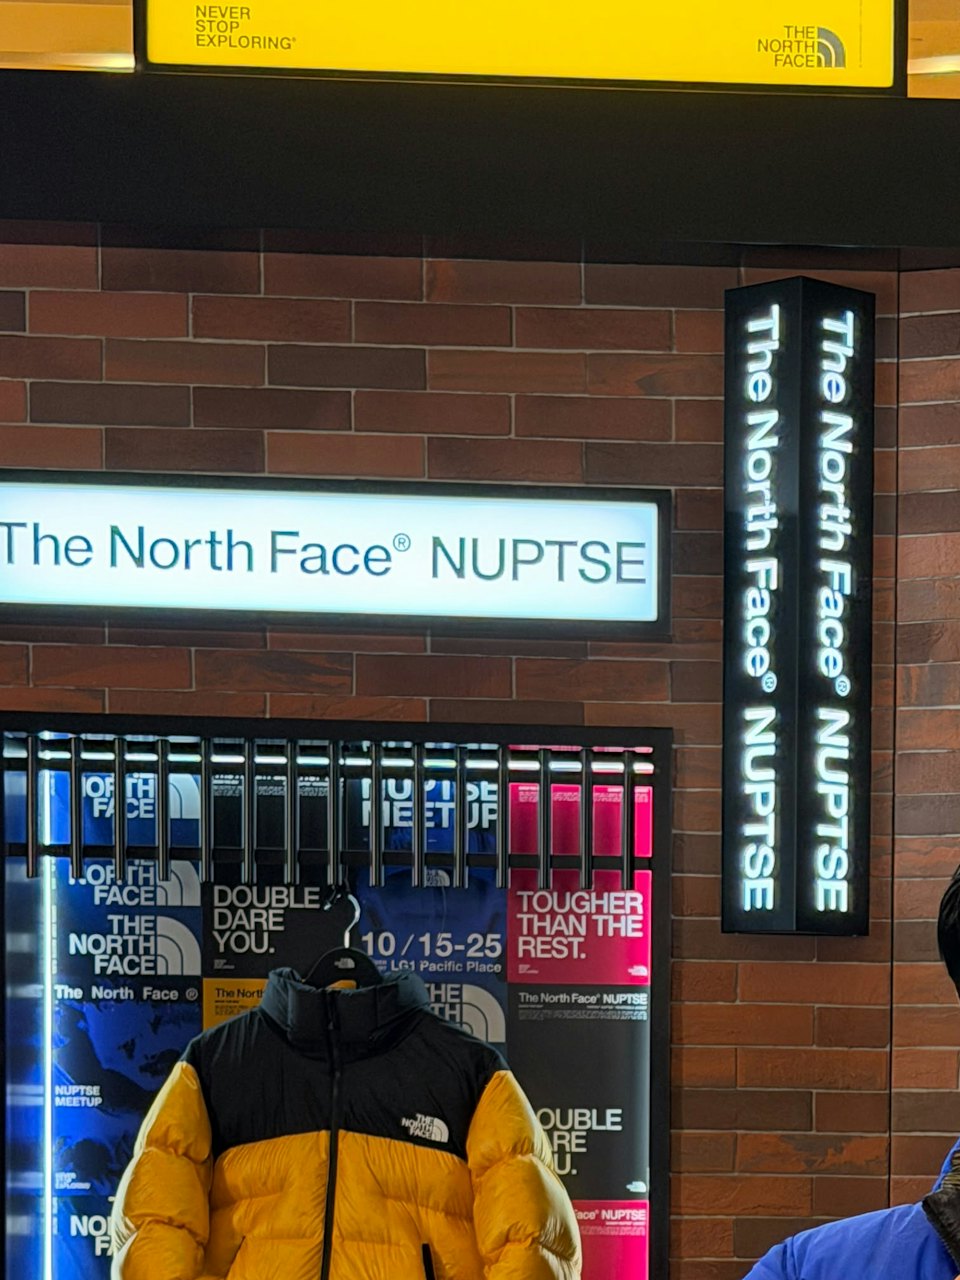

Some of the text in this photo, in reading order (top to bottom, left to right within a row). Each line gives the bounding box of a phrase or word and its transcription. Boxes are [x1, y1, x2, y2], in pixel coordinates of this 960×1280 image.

[195, 5, 250, 19] NEVER
[195, 19, 239, 33] STOP
[784, 25, 815, 39] THE
[757, 39, 815, 53] NORTH
[774, 54, 815, 68] FACE
[746, 303, 780, 402] The
[821, 309, 855, 403] The
[745, 409, 779, 551] North
[819, 411, 853, 552] North
[0, 521, 93, 567] The
[108, 525, 253, 573] North
[431, 536, 647, 586] NUPTSE
[82, 775, 155, 799] ORTH
[743, 706, 777, 912] NUPTSE
[815, 706, 850, 913] NUPTSE
[94, 885, 155, 906] FACE
[213, 885, 321, 909] DOUBLE
[516, 890, 643, 915] TOUGHER
[107, 914, 155, 935] THE
[213, 908, 285, 931] DARE
[516, 914, 643, 937] THAN THE
[69, 933, 155, 955] NORTH
[212, 930, 275, 954] YOU.
[517, 937, 585, 959] REST.
[94, 954, 155, 976] FACE
[419, 961, 461, 972] Pacific
[466, 961, 502, 973] Place
[54, 984, 179, 1000] The North Face
[215, 987, 235, 998] The
[424, 984, 461, 1003] HE
[518, 991, 539, 1003] The
[540, 992, 570, 1004] North
[602, 993, 648, 1005] NUPTSE
[55, 1085, 100, 1096] NUPTSE
[55, 1097, 103, 1107] MEETUP
[401, 1117, 433, 1132] NORTH
[416, 1113, 434, 1125] THE
[536, 1107, 622, 1130] OUBLE
[410, 1127, 433, 1140] FACE
[602, 1209, 646, 1221] NUPTSE
